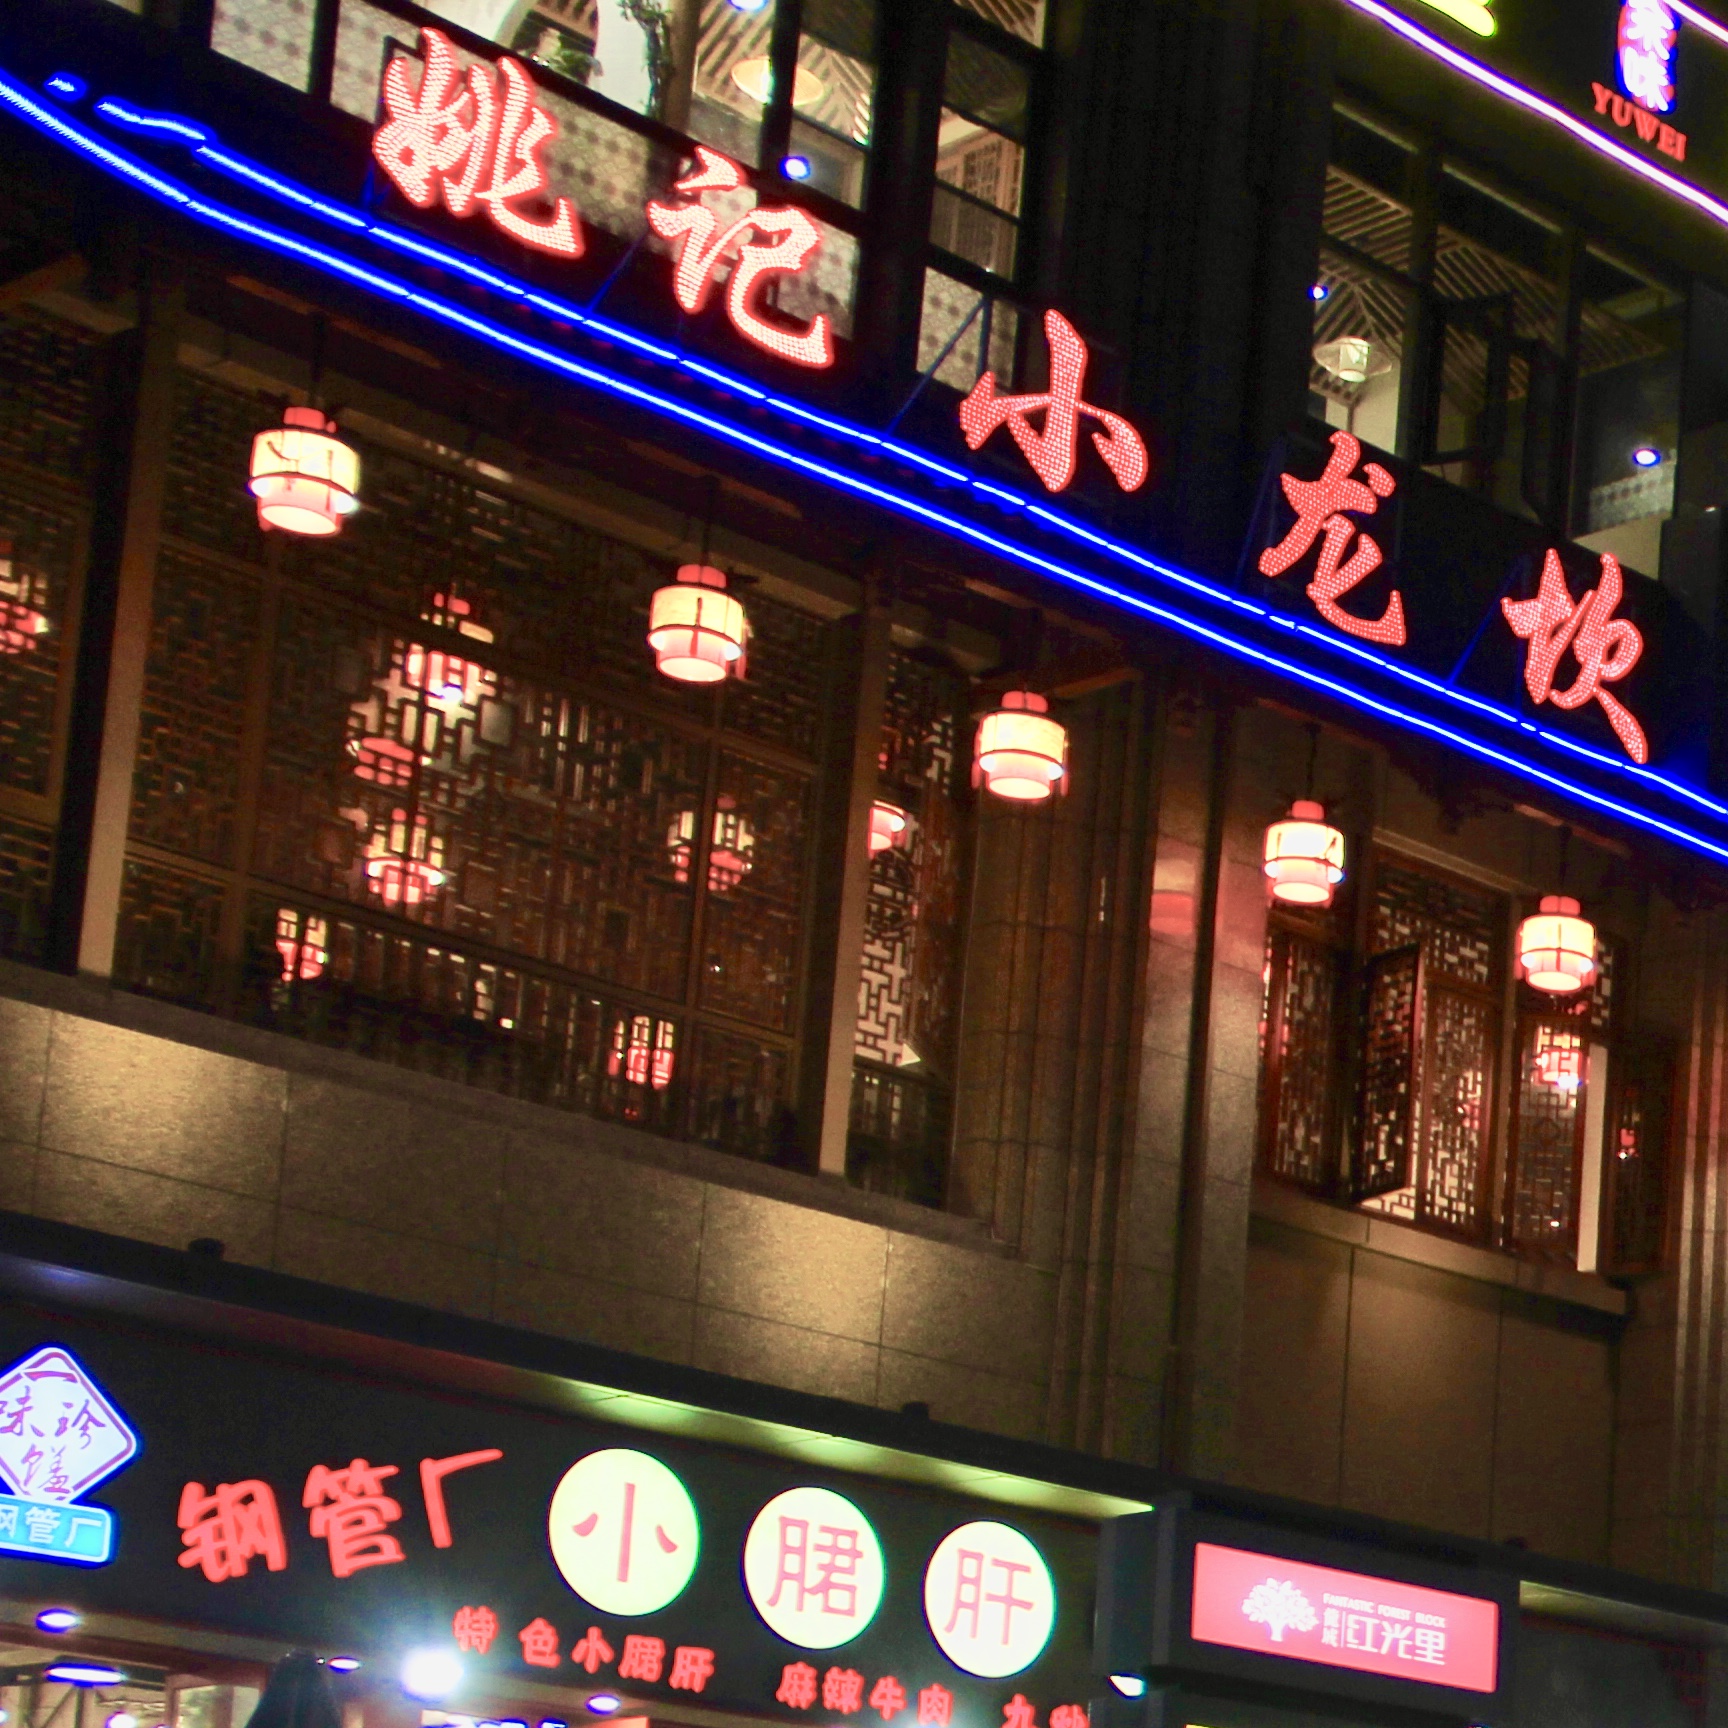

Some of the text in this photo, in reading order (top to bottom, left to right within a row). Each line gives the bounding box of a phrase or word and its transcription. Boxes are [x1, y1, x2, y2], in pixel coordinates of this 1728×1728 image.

[1591, 81, 1687, 162] YUWEI
[370, 27, 1648, 766] 姚记小龙坎
[176, 1447, 505, 1584] 钢管厂
[1346, 1614, 1447, 1666] 红光里
